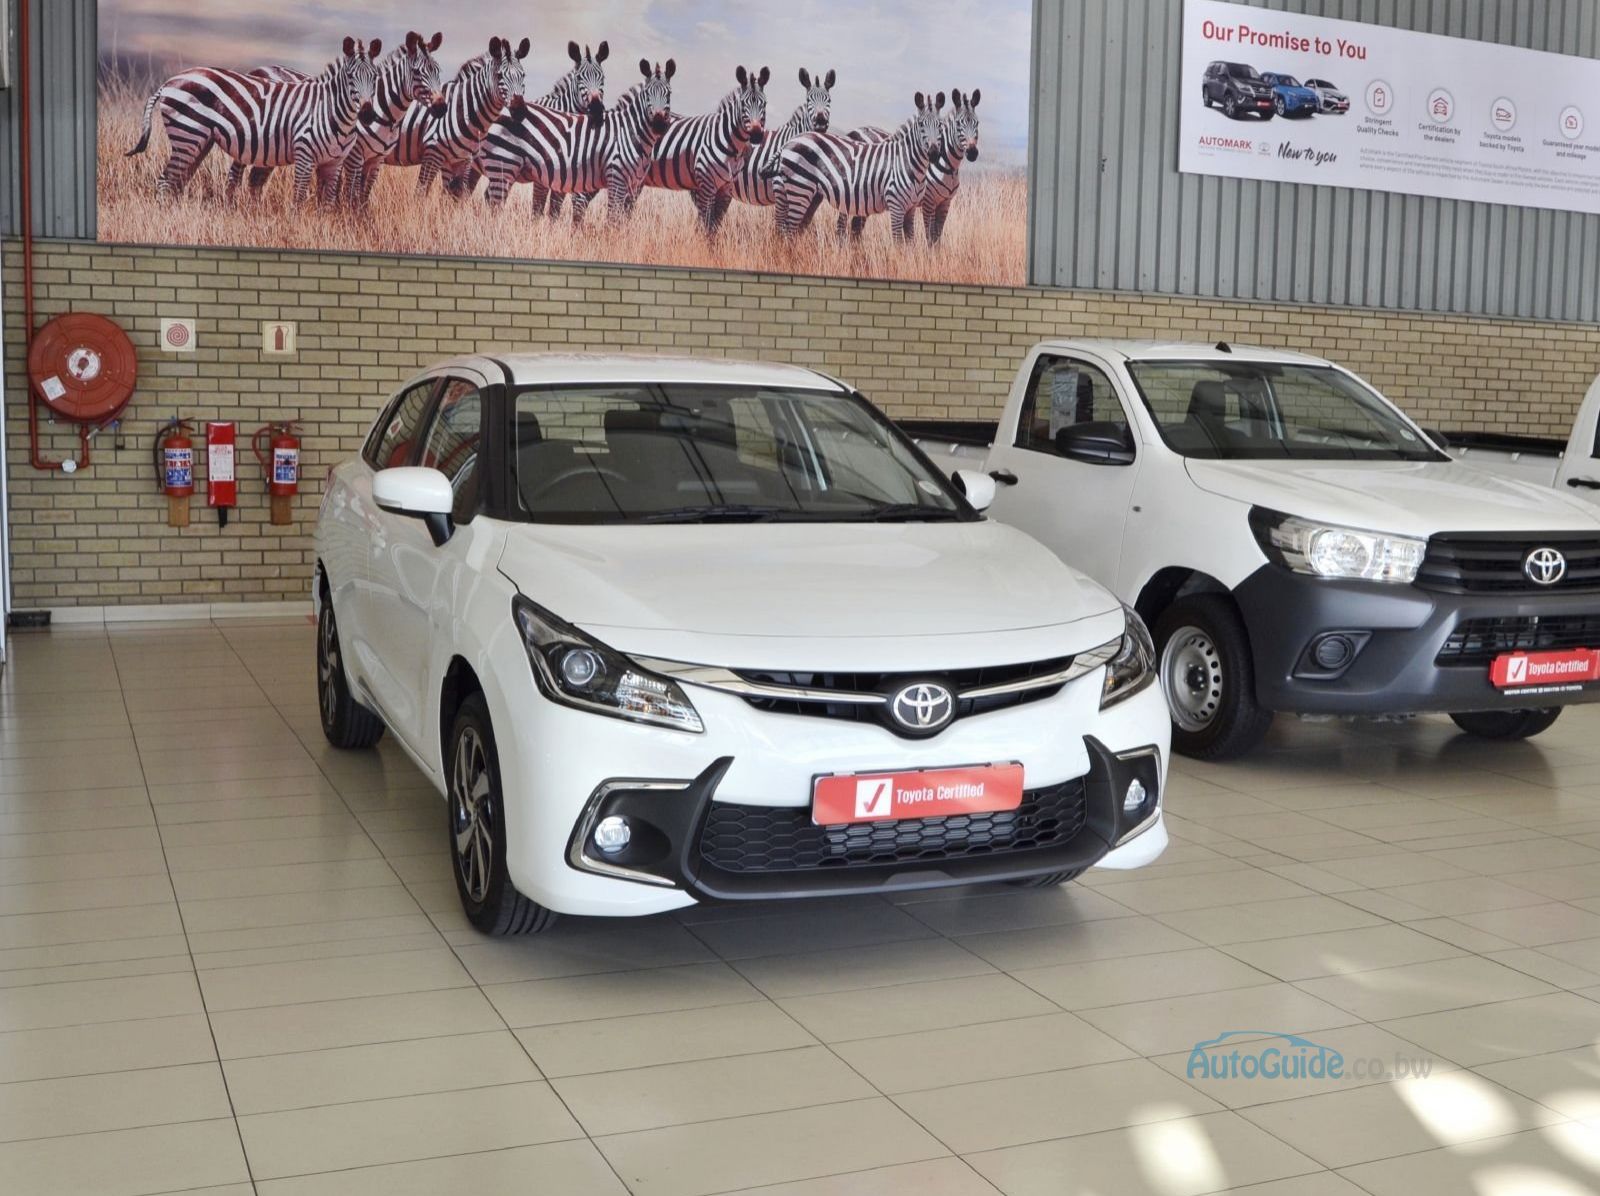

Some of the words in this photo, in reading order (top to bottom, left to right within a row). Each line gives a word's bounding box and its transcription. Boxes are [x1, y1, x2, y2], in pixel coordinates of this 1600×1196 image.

[1203, 21, 1234, 42] Our
[1239, 26, 1310, 52] Promise
[1316, 38, 1332, 55] to
[1337, 40, 1367, 60] You
[1365, 117, 1392, 126] Stringent
[1357, 126, 1377, 135] Quality
[1378, 128, 1399, 137] Checks
[1419, 124, 1454, 135] Certification
[1435, 135, 1455, 144] dealers
[1484, 132, 1501, 141] Toyota
[1199, 137, 1252, 149] AUTOMARK
[1543, 140, 1573, 149] Guaranteed
[1507, 145, 1524, 153] Toyota
[1315, 153, 1337, 166] you
[1529, 662, 1554, 675] Toyota
[1556, 660, 1589, 673] Certified
[897, 788, 934, 804] Toyota
[937, 783, 984, 799] Certified
